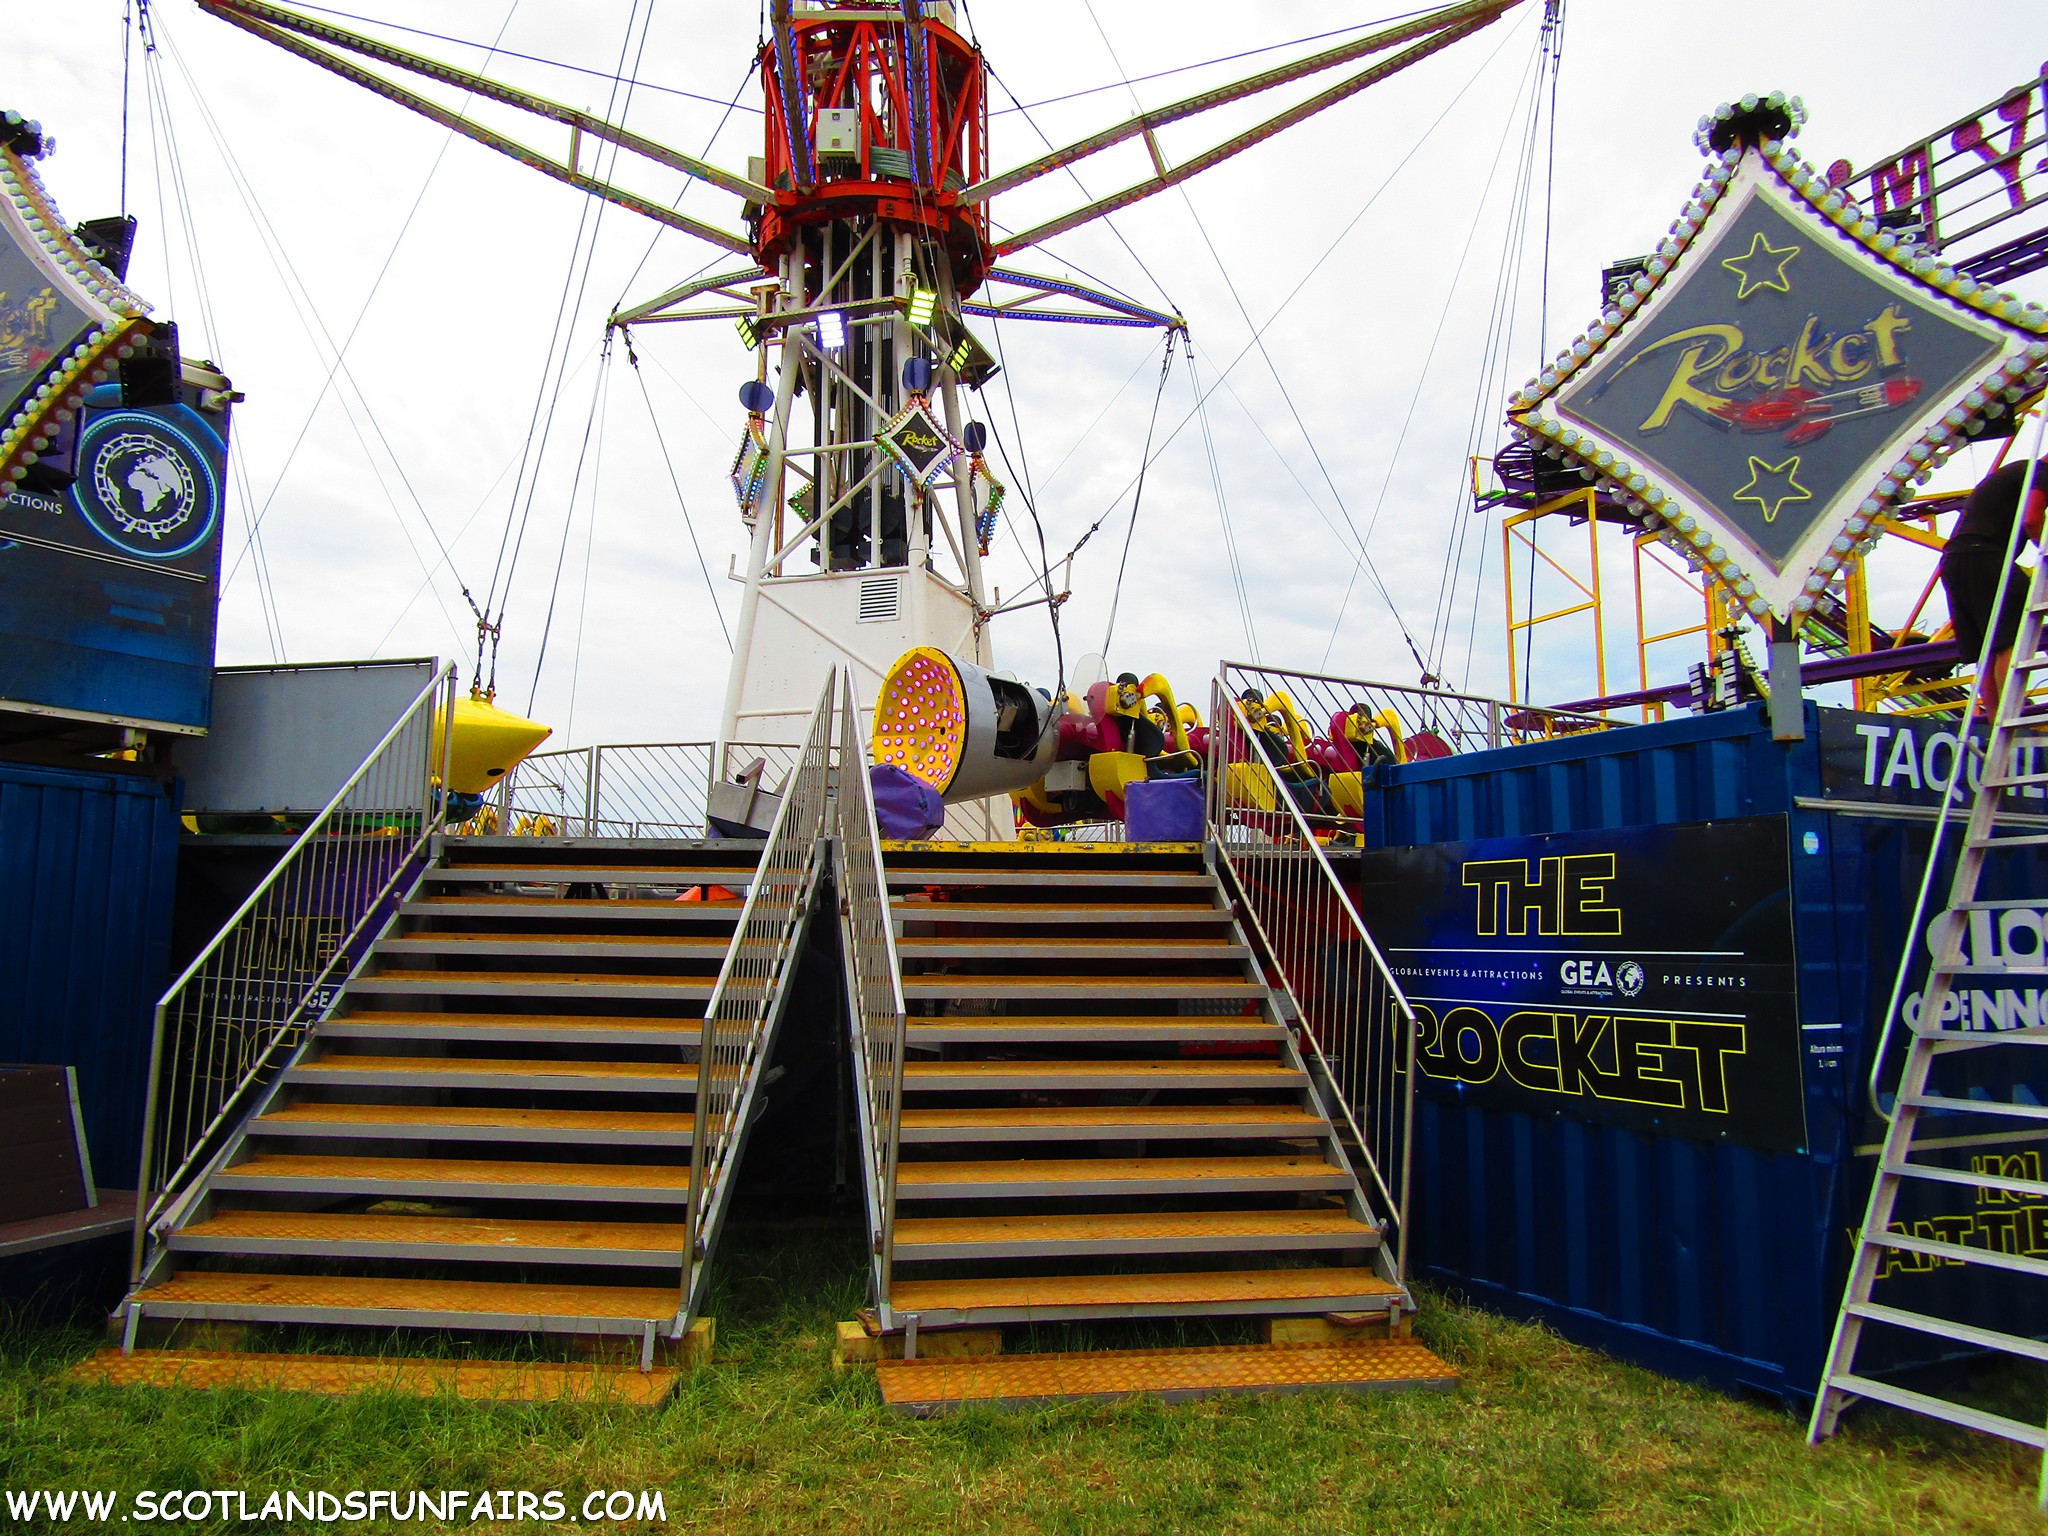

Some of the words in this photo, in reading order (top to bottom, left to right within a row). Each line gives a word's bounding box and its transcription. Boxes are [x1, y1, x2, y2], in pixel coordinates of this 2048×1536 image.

[1586, 302, 1912, 434] Rocket
[898, 430, 938, 447] Rocket
[0, 492, 63, 515] CTIONS
[1462, 852, 1622, 936] THE
[1425, 968, 1460, 978] EVENTS
[1463, 969, 1469, 978] &
[1471, 969, 1543, 981] ATTRACTIONS
[1560, 960, 1613, 987] GEA
[1663, 975, 1746, 987] PRESENTS
[1391, 1003, 1747, 1114] ROCKET
